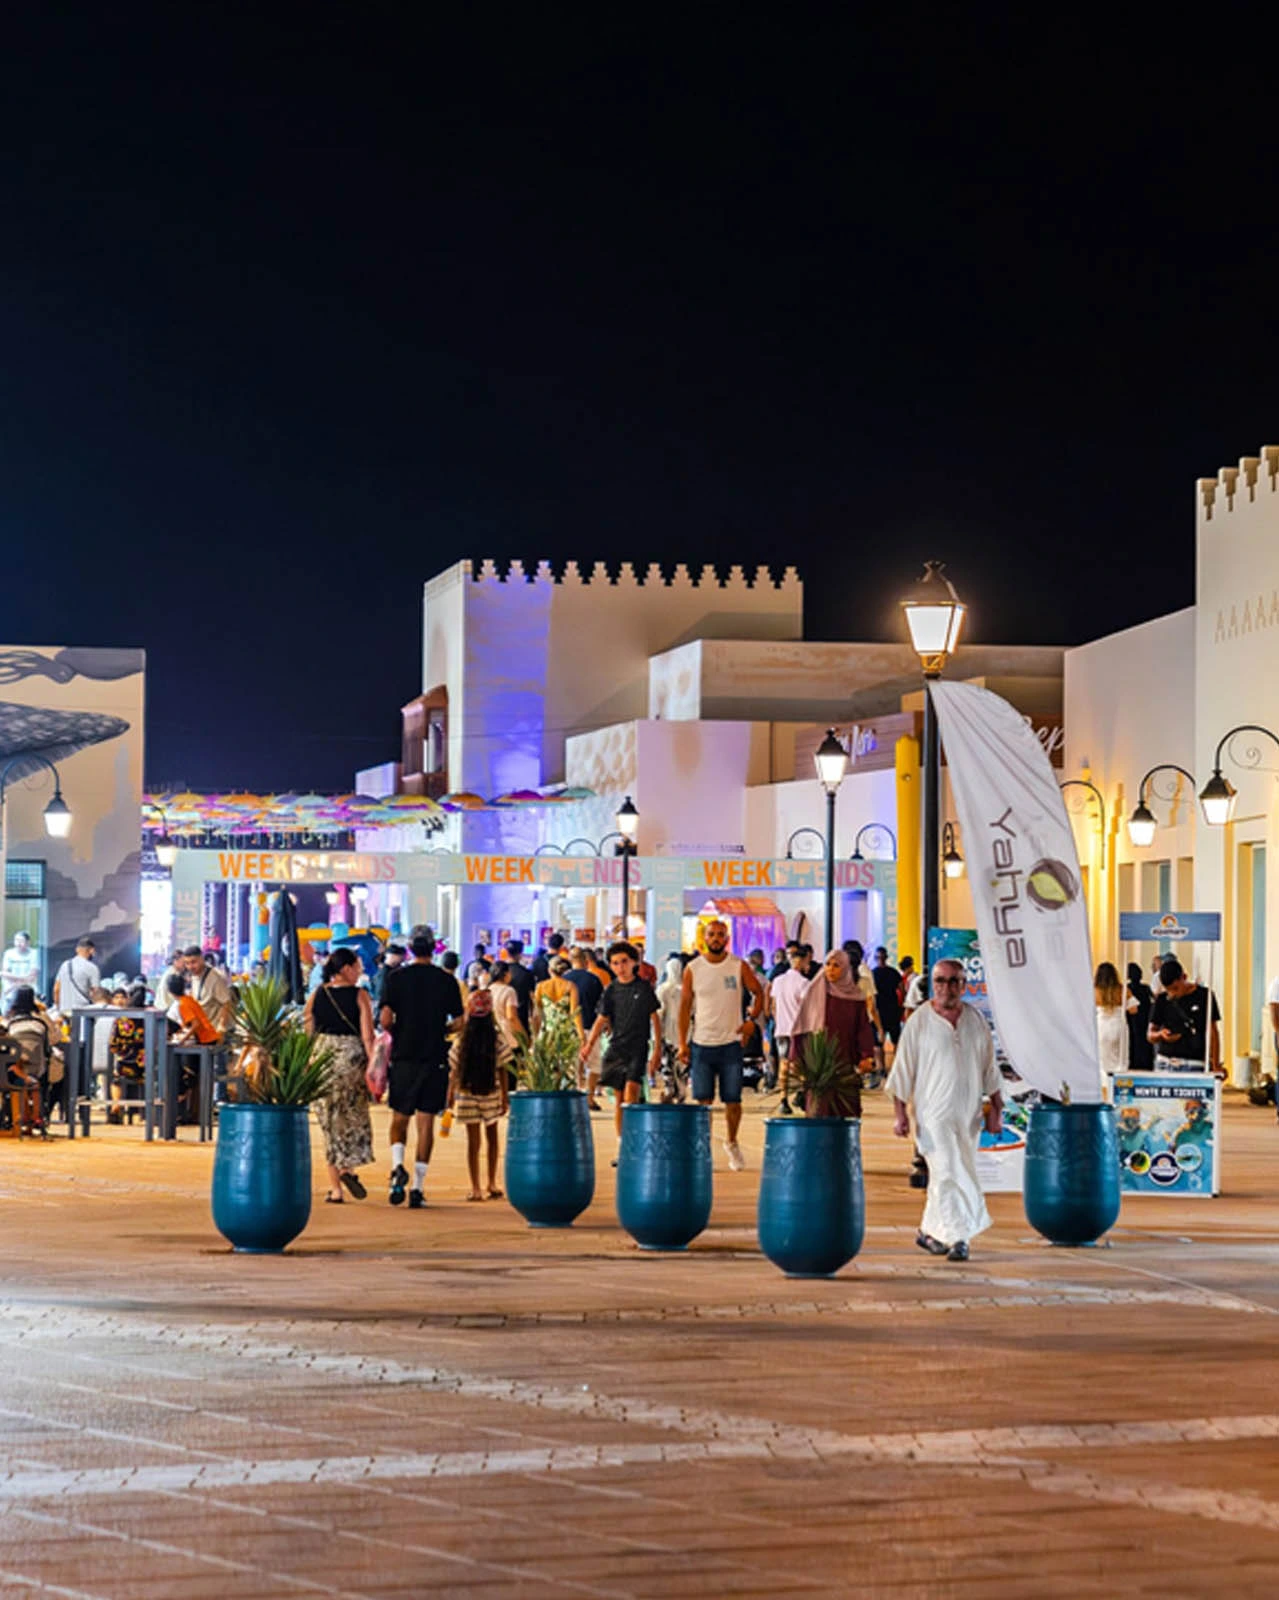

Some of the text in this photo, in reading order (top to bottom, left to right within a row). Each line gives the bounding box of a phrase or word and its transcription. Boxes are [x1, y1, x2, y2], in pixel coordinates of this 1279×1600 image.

[219, 853, 290, 879] WEEK
[464, 856, 535, 882] WEEK
[703, 860, 772, 887] WEEK
[989, 807, 1027, 969] Yahya
